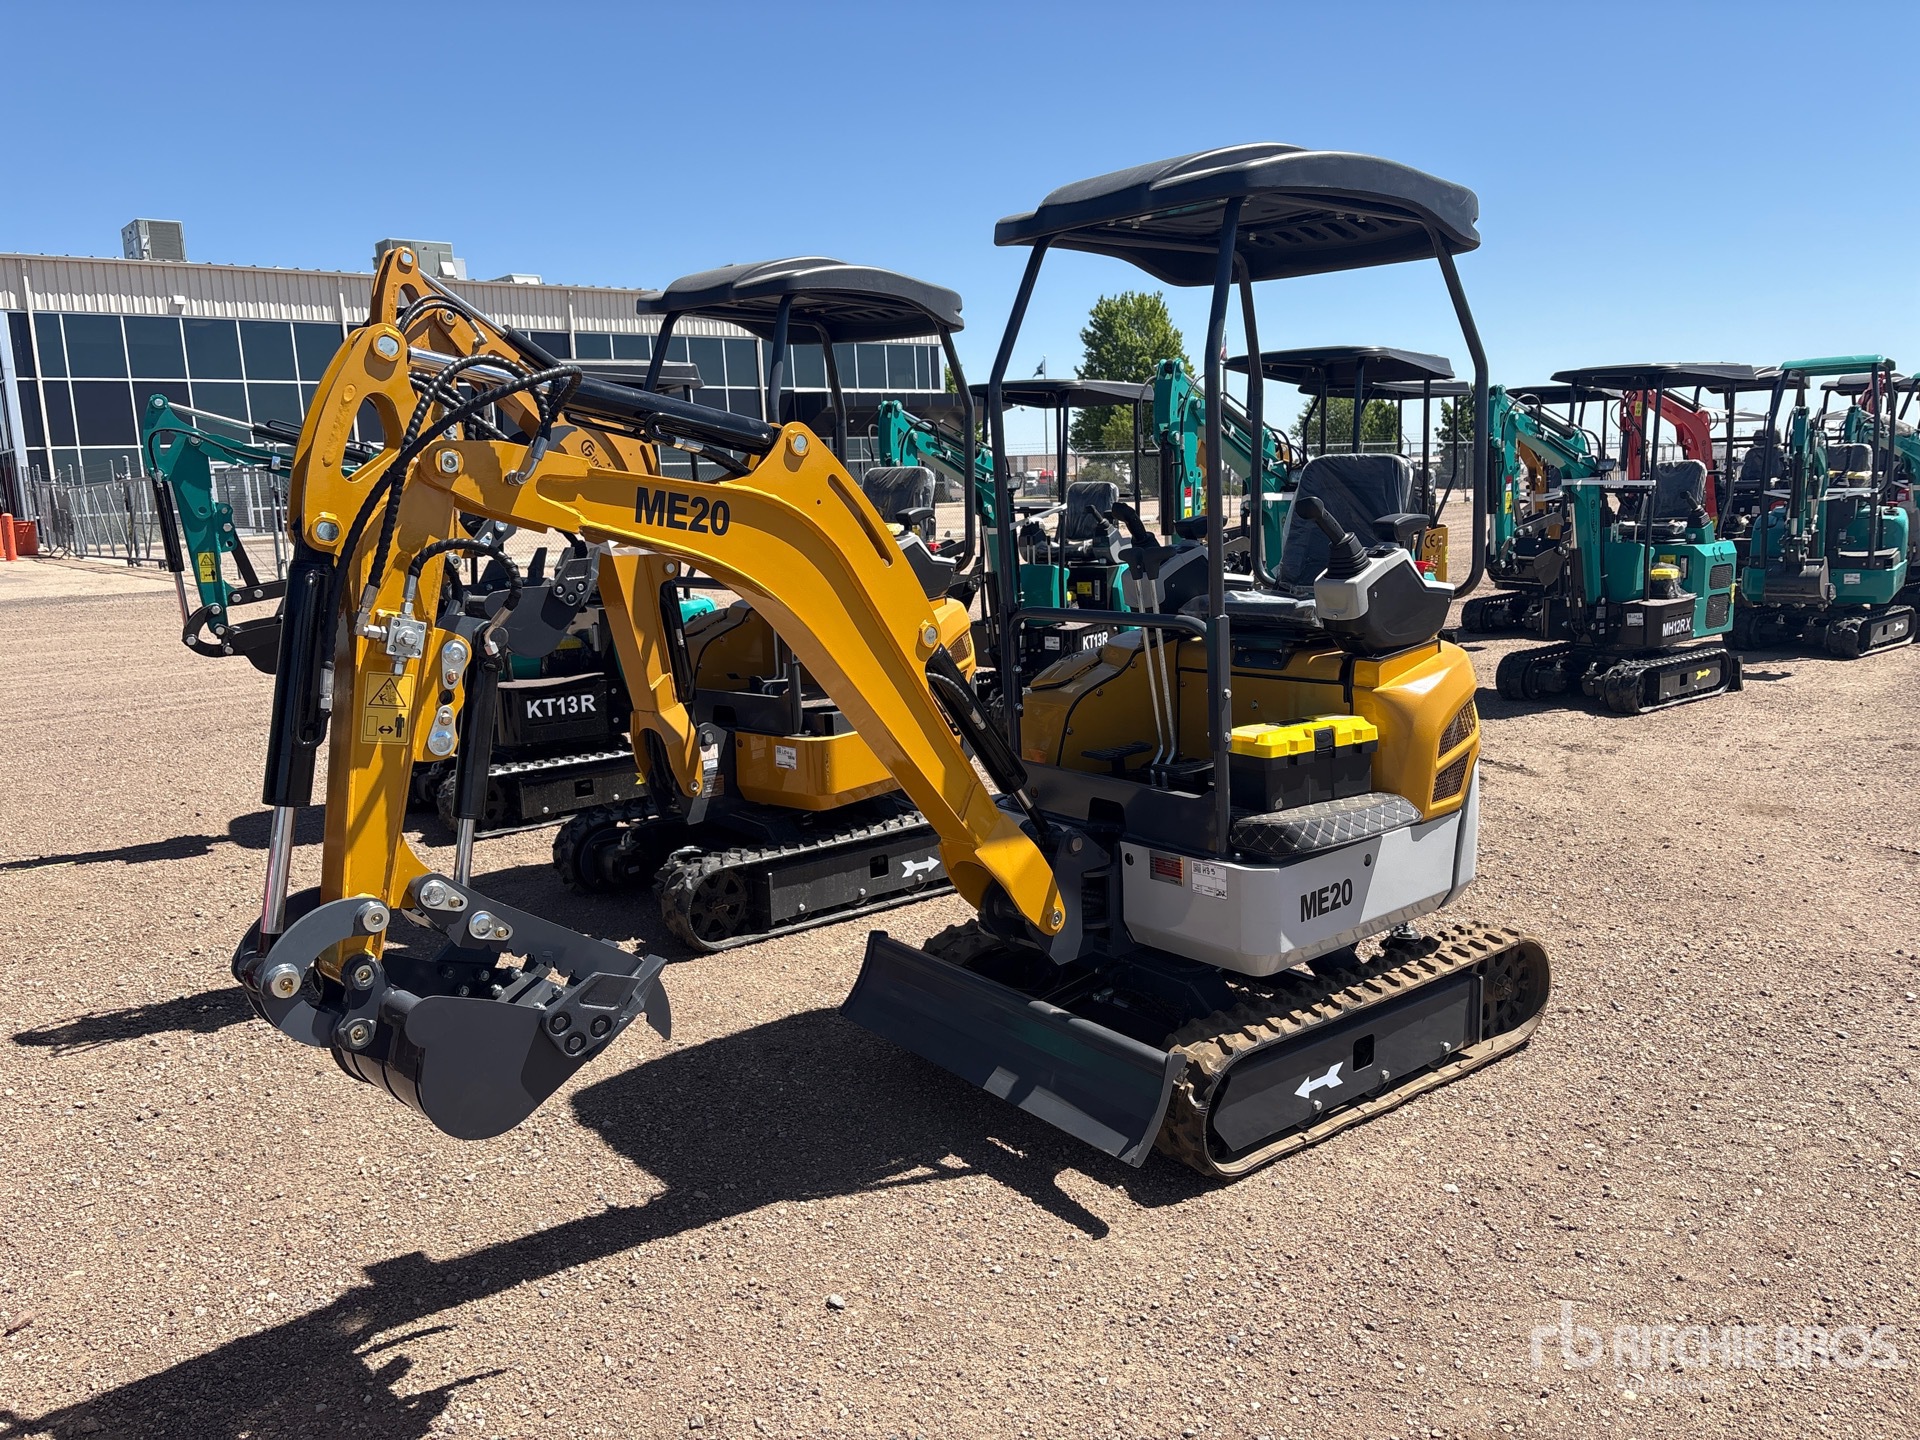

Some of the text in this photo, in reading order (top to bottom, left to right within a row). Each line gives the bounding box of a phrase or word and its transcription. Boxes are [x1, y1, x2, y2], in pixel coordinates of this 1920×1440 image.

[635, 486, 730, 536] ME20
[1662, 617, 1691, 637] MH12RX
[1082, 631, 1108, 650] KT13R
[526, 694, 597, 719] KT13R
[1300, 878, 1353, 923] ME20
